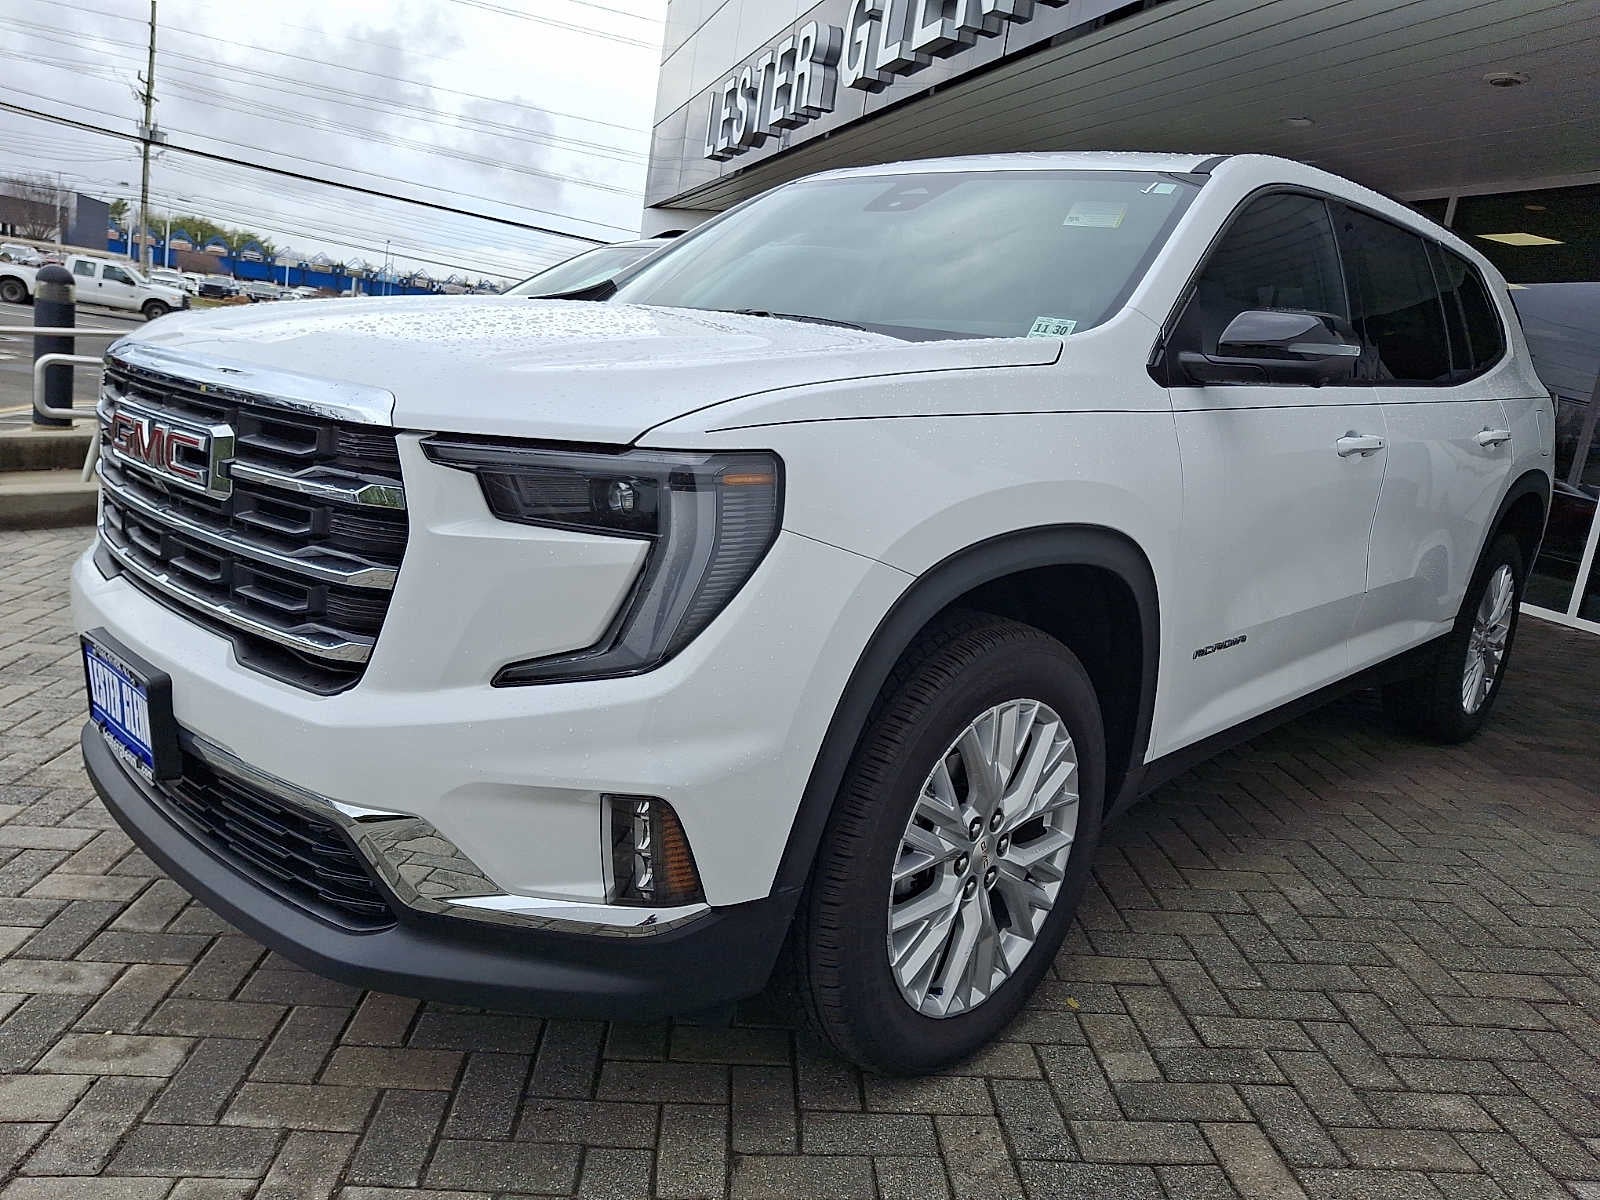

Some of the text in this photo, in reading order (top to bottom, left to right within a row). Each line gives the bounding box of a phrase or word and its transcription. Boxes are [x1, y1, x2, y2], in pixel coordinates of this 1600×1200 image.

[704, 20, 842, 161] LESTER
[1033, 323, 1068, 336] 11 30
[111, 408, 208, 487] GMC
